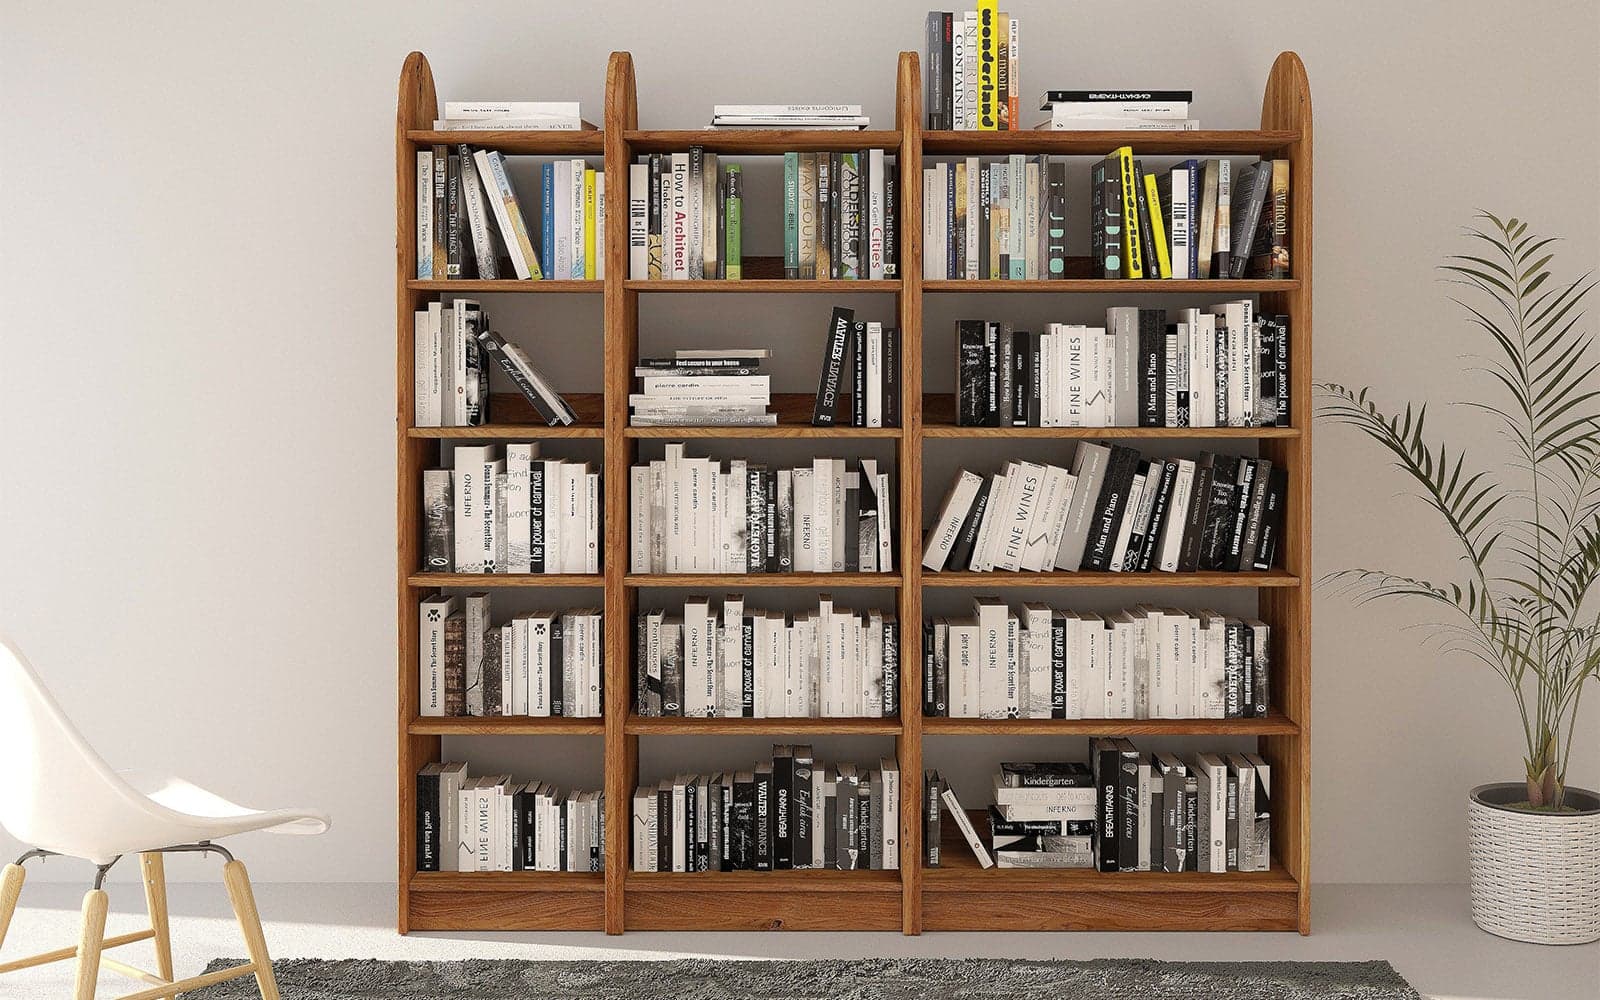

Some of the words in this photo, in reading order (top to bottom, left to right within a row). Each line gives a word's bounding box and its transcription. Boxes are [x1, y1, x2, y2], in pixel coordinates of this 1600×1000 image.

[955, 34, 963, 125] CONTAINER
[966, 16, 977, 129] INTERIORS
[982, 8, 994, 127] wonderland
[999, 59, 1007, 90] moon
[693, 149, 699, 161] TO
[449, 176, 457, 204] YOUNG
[674, 163, 685, 192] How
[662, 179, 671, 209] Choke
[674, 195, 684, 207] to
[871, 191, 880, 205] Jan
[1275, 184, 1287, 203] ew
[449, 212, 457, 226] THE
[631, 199, 645, 217] FILM
[802, 159, 813, 276] MAYBOURNE
[849, 171, 859, 260] ALDERSHOT
[1124, 155, 1140, 271] wonderland
[1173, 202, 1187, 219] FILM
[1275, 205, 1287, 235] moon
[449, 231, 457, 255] SHACK
[631, 228, 645, 246] FILM
[674, 211, 686, 272] Architect
[871, 227, 882, 269] Cities
[1173, 229, 1187, 247] FILM
[1275, 325, 1287, 359] carnival
[1069, 337, 1081, 381] WINES
[1147, 353, 1157, 375] Piano
[1243, 354, 1251, 365] The
[1276, 360, 1287, 370] of
[1147, 377, 1157, 392] and
[1277, 371, 1288, 399] power
[1069, 386, 1081, 415] FINE
[1147, 393, 1157, 411] Man
[1276, 400, 1286, 416] The
[464, 473, 472, 517] INFERNO
[530, 470, 542, 505] carnival
[531, 506, 542, 516] of
[1006, 526, 1024, 558] FINE
[1015, 476, 1037, 521] WINES
[1104, 493, 1119, 517] Piano
[532, 518, 543, 545] power
[802, 514, 811, 549] INFERNO
[939, 516, 961, 551] INFERNO
[1100, 518, 1112, 533] and
[1247, 531, 1256, 544] How
[530, 547, 541, 562] The
[1094, 534, 1108, 554] Man
[578, 623, 586, 642] pierre
[1052, 626, 1063, 657] carnival
[578, 643, 586, 661] cardin
[1052, 659, 1063, 668] of
[744, 668, 754, 692] power
[1053, 671, 1066, 694] power
[743, 694, 752, 708] The
[1052, 696, 1063, 710] The
[1024, 776, 1074, 787] Kindergarten
[758, 781, 767, 817] WALTER
[794, 790, 813, 817] English
[1105, 785, 1114, 838] BREATHTAKING
[1121, 786, 1139, 816] English
[778, 789, 787, 837] BREATHTAKING
[858, 800, 869, 851] Kindergarten
[1186, 798, 1196, 852] Kindergarten
[758, 817, 767, 855] FINANCE
[1126, 816, 1134, 839] circus
